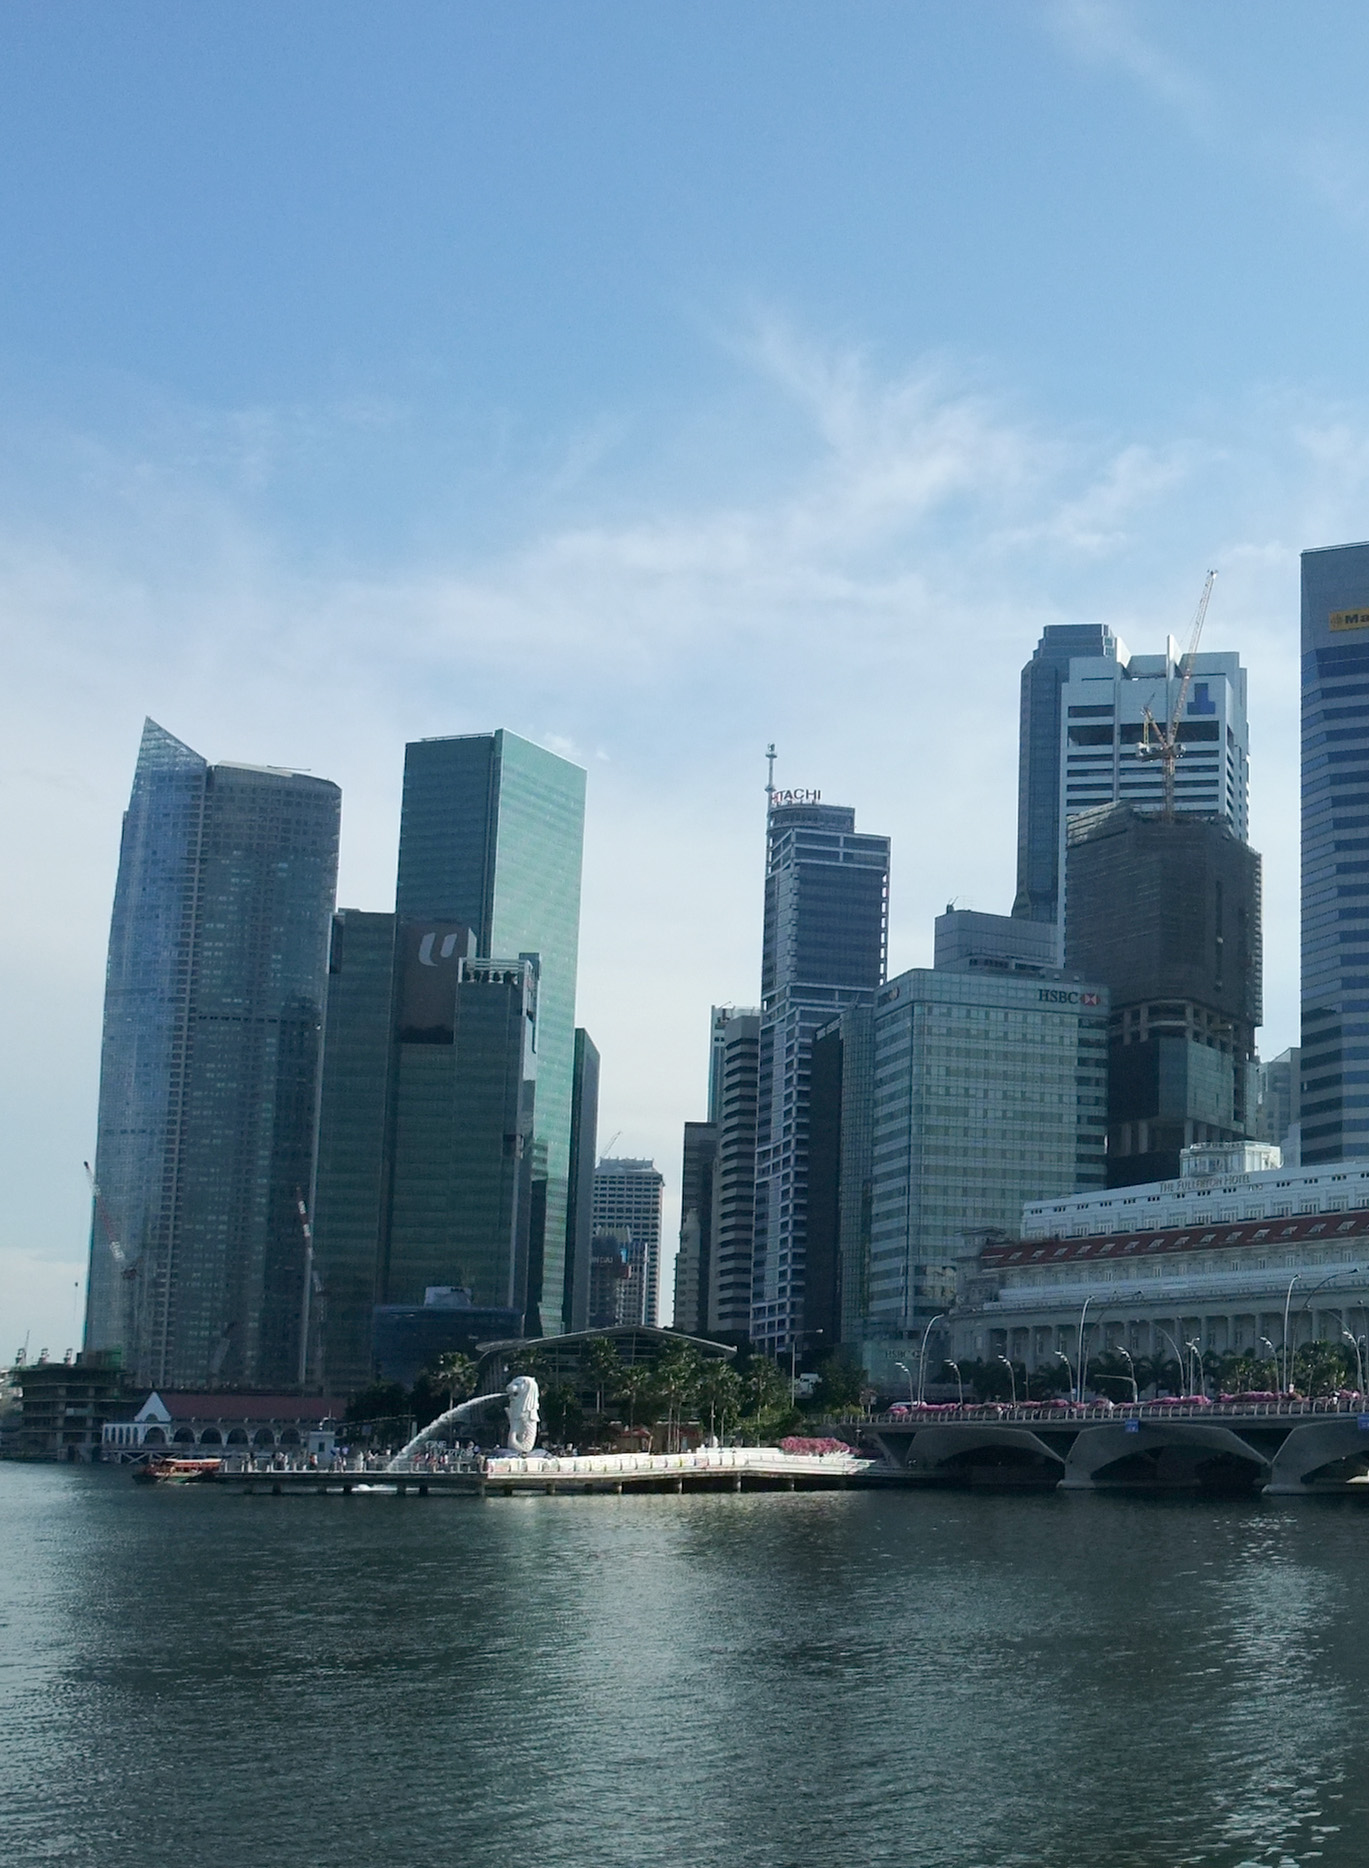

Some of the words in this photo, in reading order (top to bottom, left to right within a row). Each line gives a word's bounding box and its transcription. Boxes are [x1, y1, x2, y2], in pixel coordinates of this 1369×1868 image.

[1038, 989, 1079, 1004] HSBC
[1160, 1181, 1174, 1193] THE
[1177, 1177, 1222, 1190] FULLERTON
[1224, 1174, 1250, 1185] HOTEL
